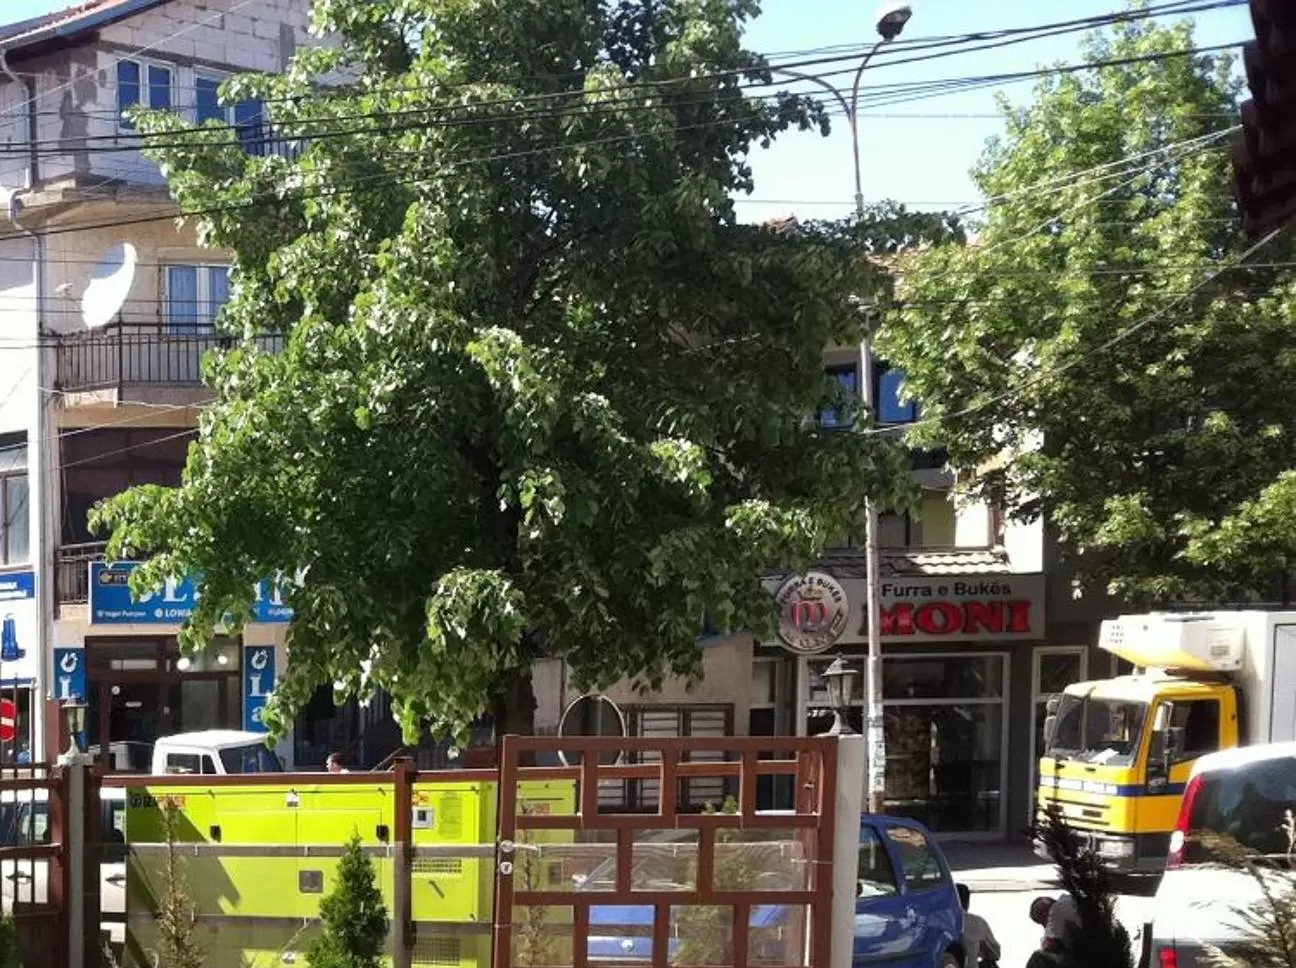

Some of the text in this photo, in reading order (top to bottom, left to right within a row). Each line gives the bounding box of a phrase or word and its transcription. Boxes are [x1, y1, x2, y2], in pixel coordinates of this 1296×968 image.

[881, 583, 932, 598] Furra
[938, 585, 949, 597] e
[857, 600, 1032, 637] MONI
